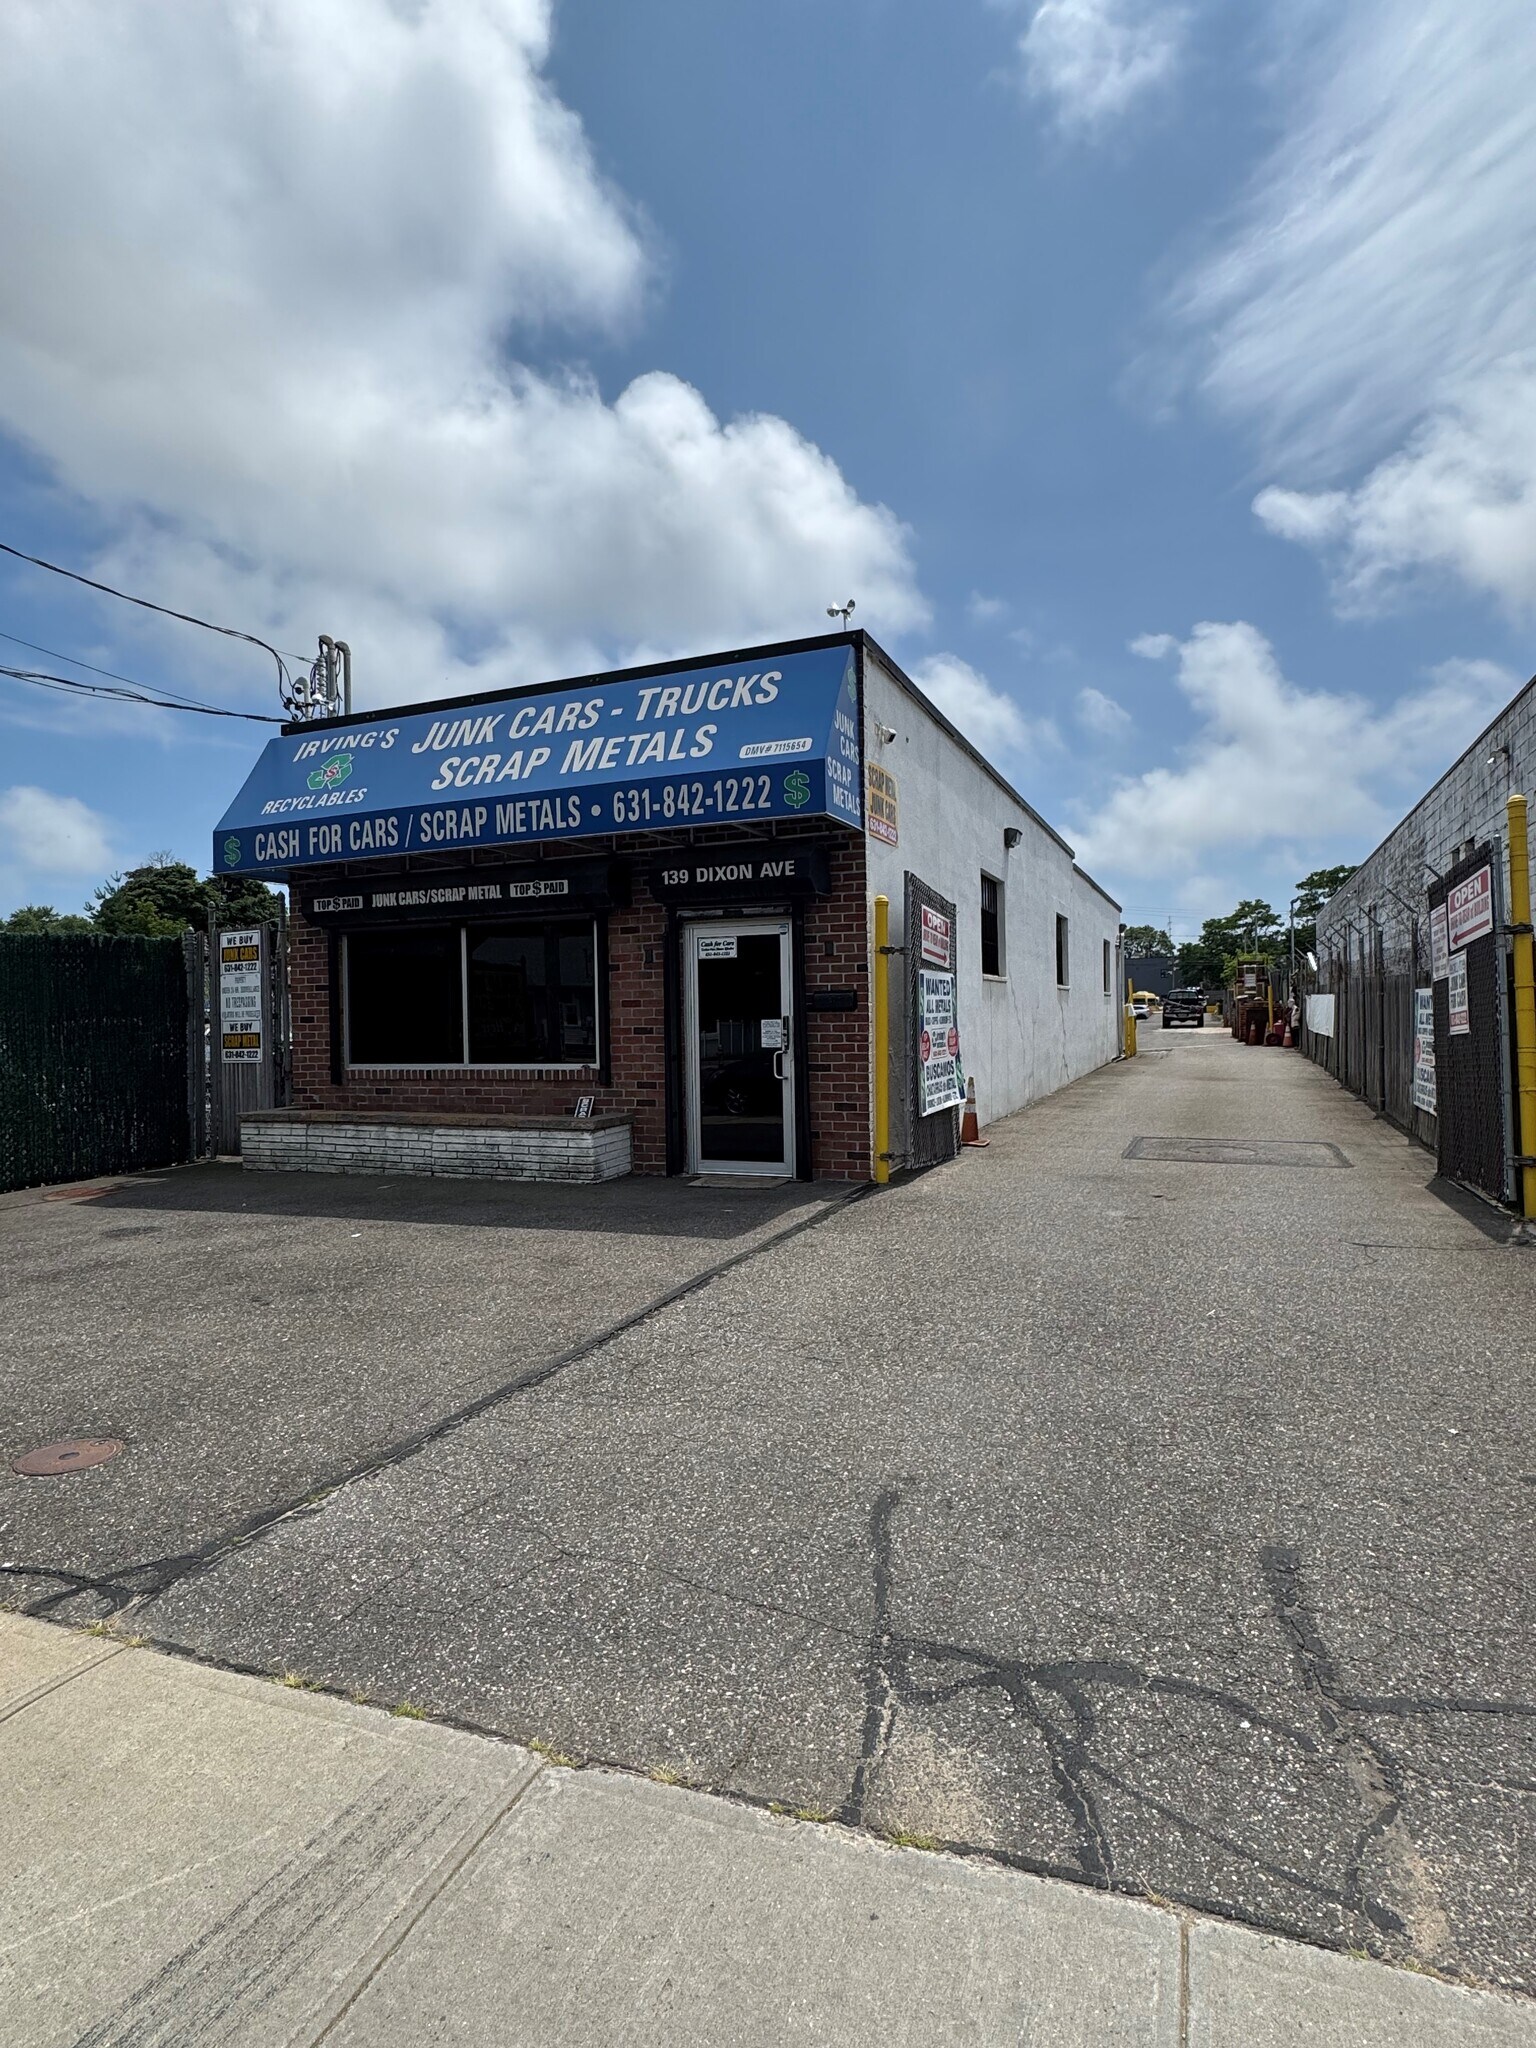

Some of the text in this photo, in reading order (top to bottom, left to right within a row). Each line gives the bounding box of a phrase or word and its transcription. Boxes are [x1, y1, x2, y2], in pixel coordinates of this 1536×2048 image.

[411, 713, 505, 754] JUNK
[508, 698, 605, 740] CARS
[635, 671, 782, 722] TRUCKS
[834, 709, 855, 740] JUNK
[292, 728, 400, 763] IRVING'S
[430, 724, 718, 791] SCRAP METALS
[745, 740, 807, 756] DMV# 7115654
[840, 736, 860, 766] CARS
[827, 756, 852, 787] SCRAP
[868, 765, 884, 793] SCRAP
[261, 788, 368, 816] RECYCLABLES
[833, 784, 861, 817] METALS
[255, 829, 300, 861] CASH
[309, 824, 342, 856] FOR
[350, 816, 399, 850] CARS
[420, 806, 487, 843] SCRAP
[496, 795, 581, 835] METALS
[613, 775, 772, 823] 631-842-1222
[661, 860, 796, 885] 139 DIXON AVE
[371, 884, 502, 908] JUNK CARS/SCRAP METAL
[513, 884, 531, 896] TOP
[543, 881, 565, 894] PAID
[1454, 876, 1482, 909] OPEN
[317, 900, 332, 911] TOP
[342, 897, 360, 909] PAID
[927, 911, 946, 935] OPEN
[226, 934, 254, 946] WE BUY
[240, 946, 258, 961] CARS
[925, 977, 950, 996] WANTED
[229, 1022, 253, 1032] WE BUY
[926, 1059, 955, 1082] BUSCAMOS
